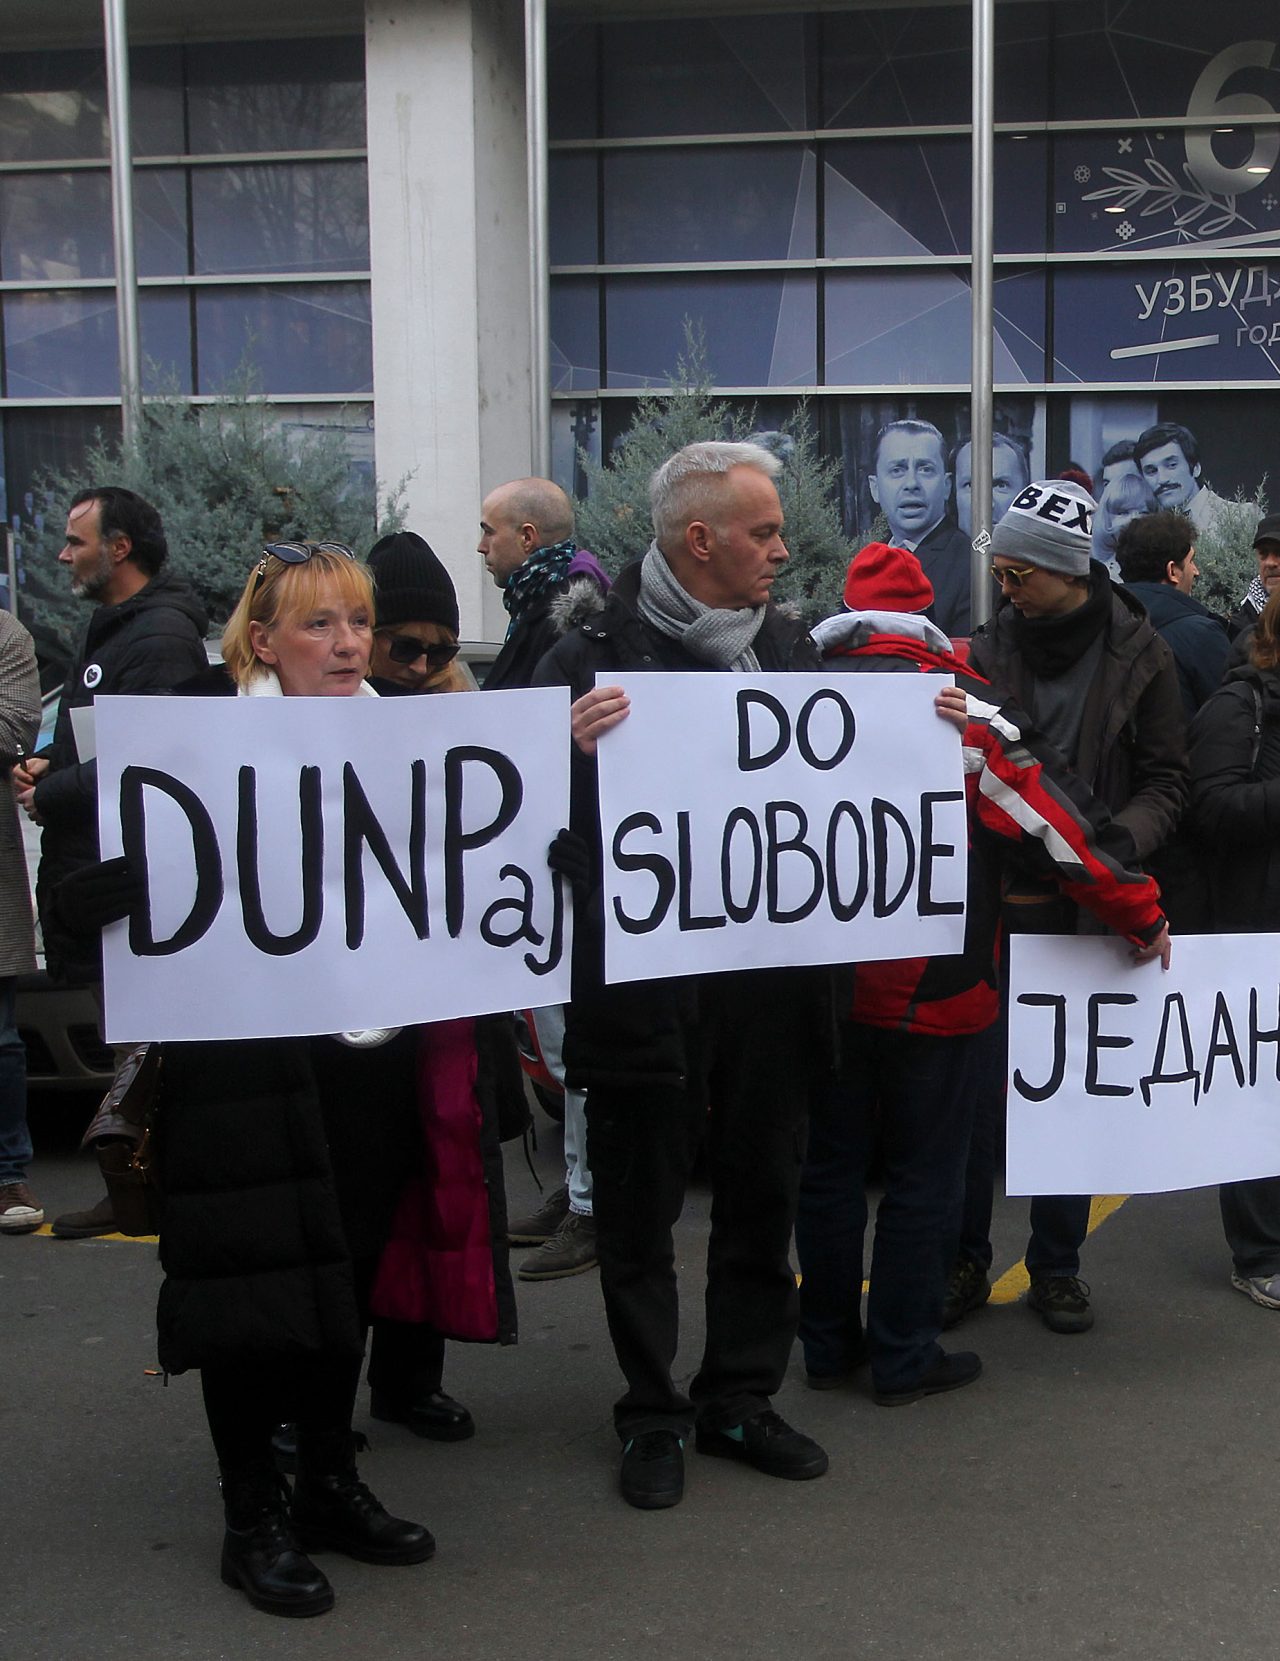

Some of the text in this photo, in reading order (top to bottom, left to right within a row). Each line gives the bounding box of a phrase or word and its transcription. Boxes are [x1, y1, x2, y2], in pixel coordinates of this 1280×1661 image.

[736, 688, 856, 772] DO
[119, 745, 564, 976] DUNPaj
[612, 790, 966, 935] SLOBODE
